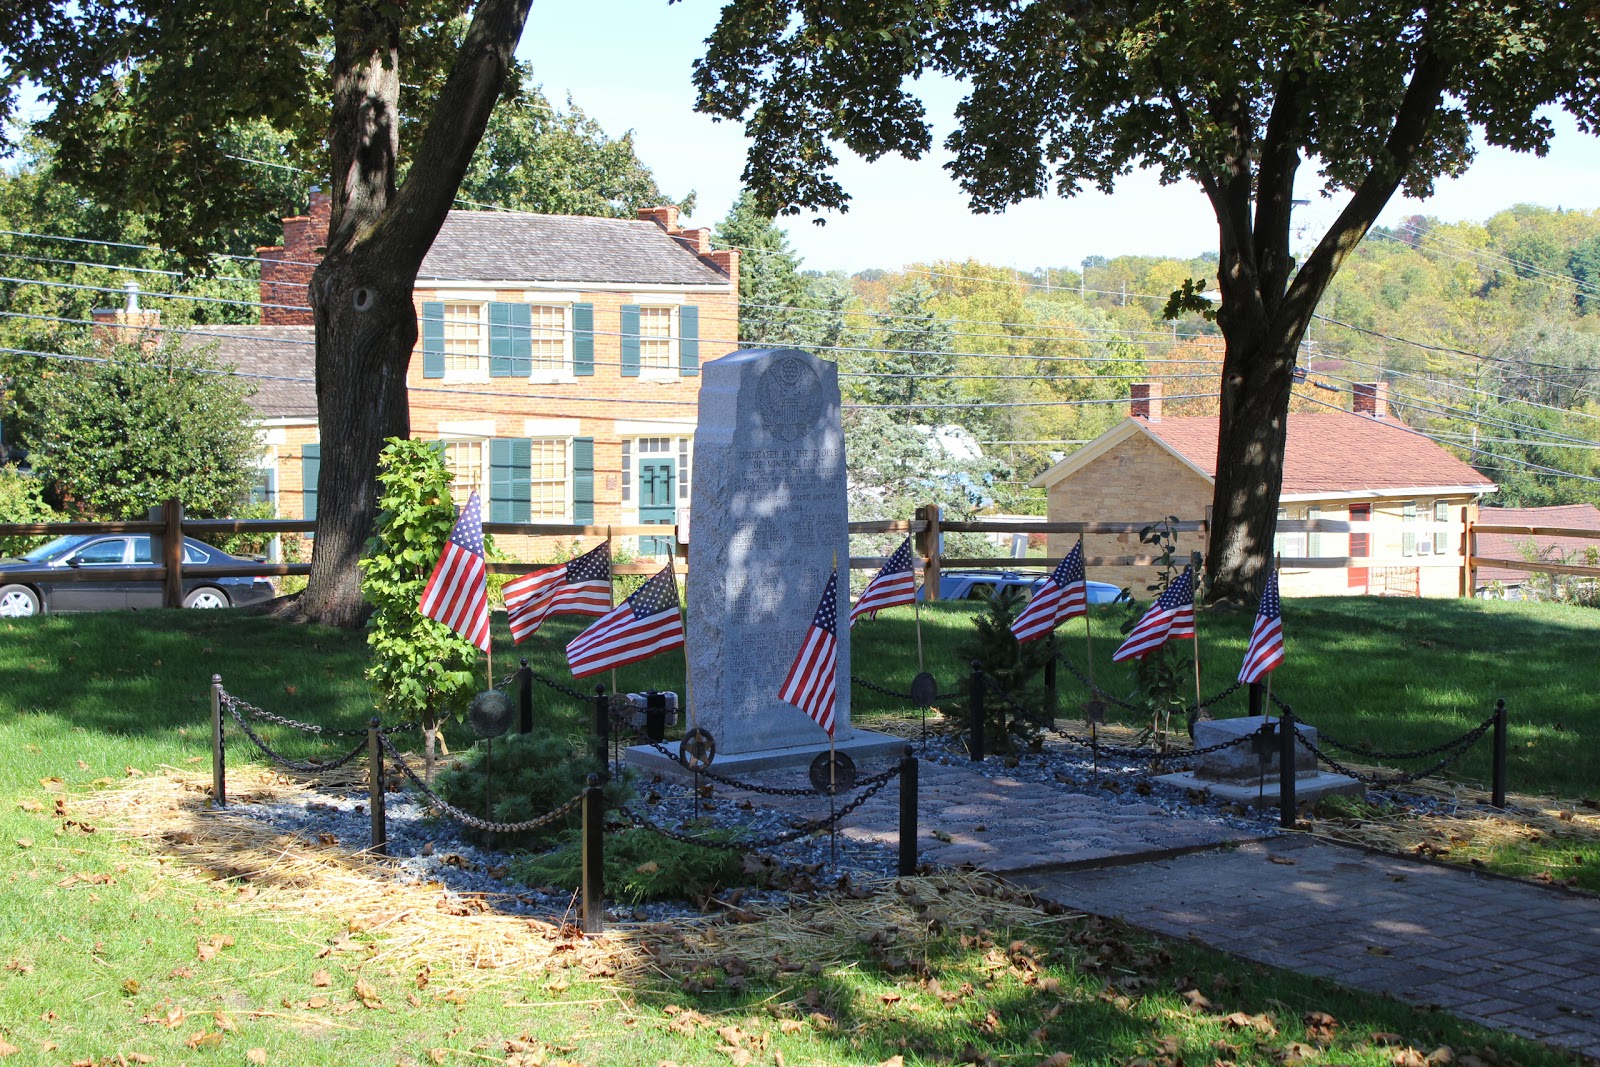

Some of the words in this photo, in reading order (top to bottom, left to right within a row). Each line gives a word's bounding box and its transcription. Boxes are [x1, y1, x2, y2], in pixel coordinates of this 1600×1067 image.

[739, 449, 779, 460] DEDICATED
[782, 449, 791, 458] BY
[795, 449, 808, 458] THE
[813, 448, 839, 458] PEOPLE
[753, 460, 763, 469] OF
[767, 459, 800, 468] MINERAL
[803, 458, 826, 467] POINT
